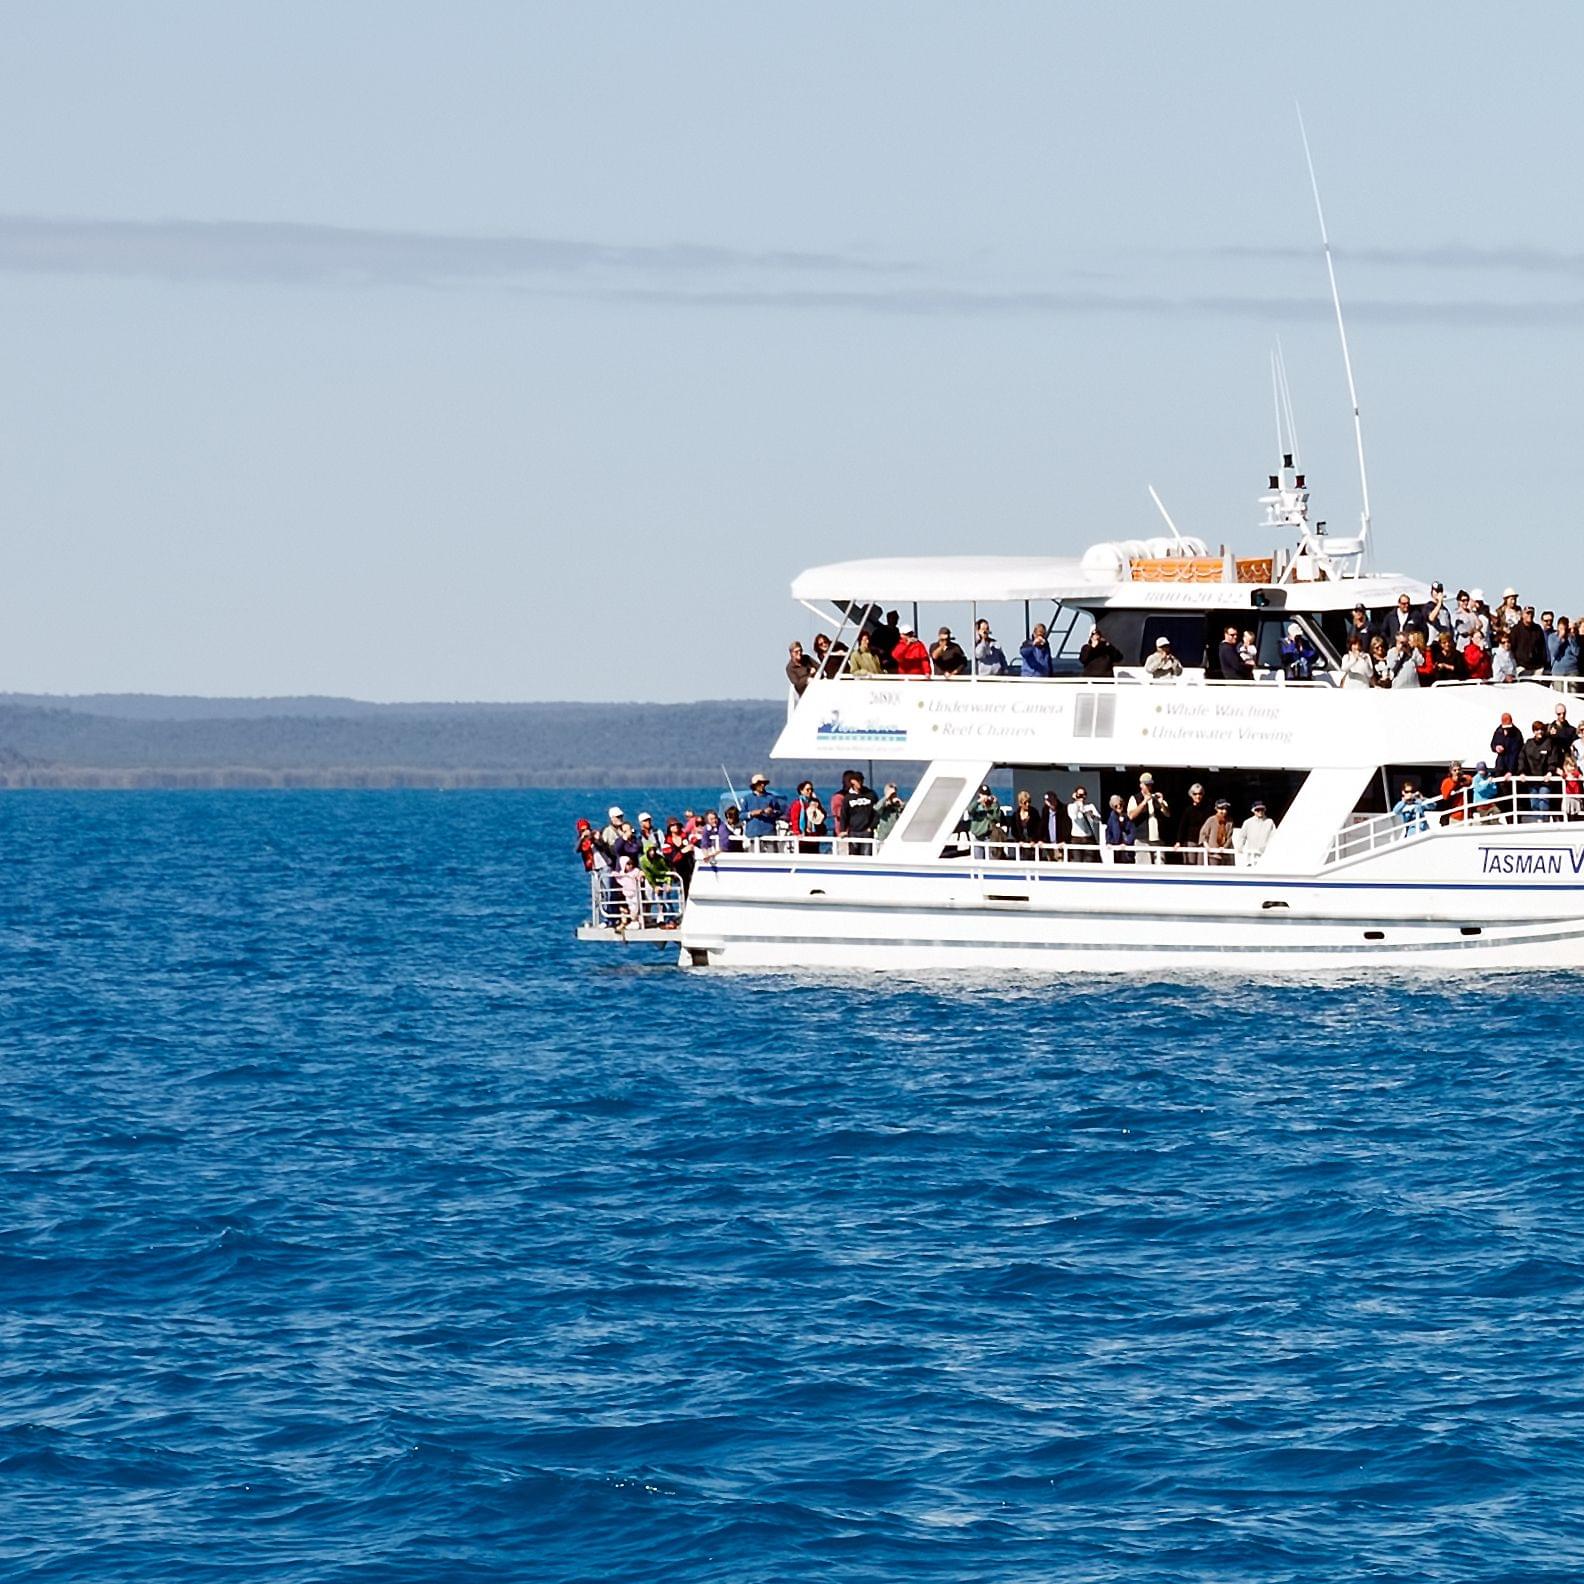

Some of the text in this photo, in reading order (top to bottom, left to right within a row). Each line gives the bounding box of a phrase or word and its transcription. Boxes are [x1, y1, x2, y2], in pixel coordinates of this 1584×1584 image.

[928, 699, 1064, 714] Underwater Camera
[1166, 702, 1280, 720] Whale Watching
[942, 721, 973, 736] Reef
[1152, 725, 1294, 744] Underwater Viewing
[1478, 847, 1562, 874] TASMAN
